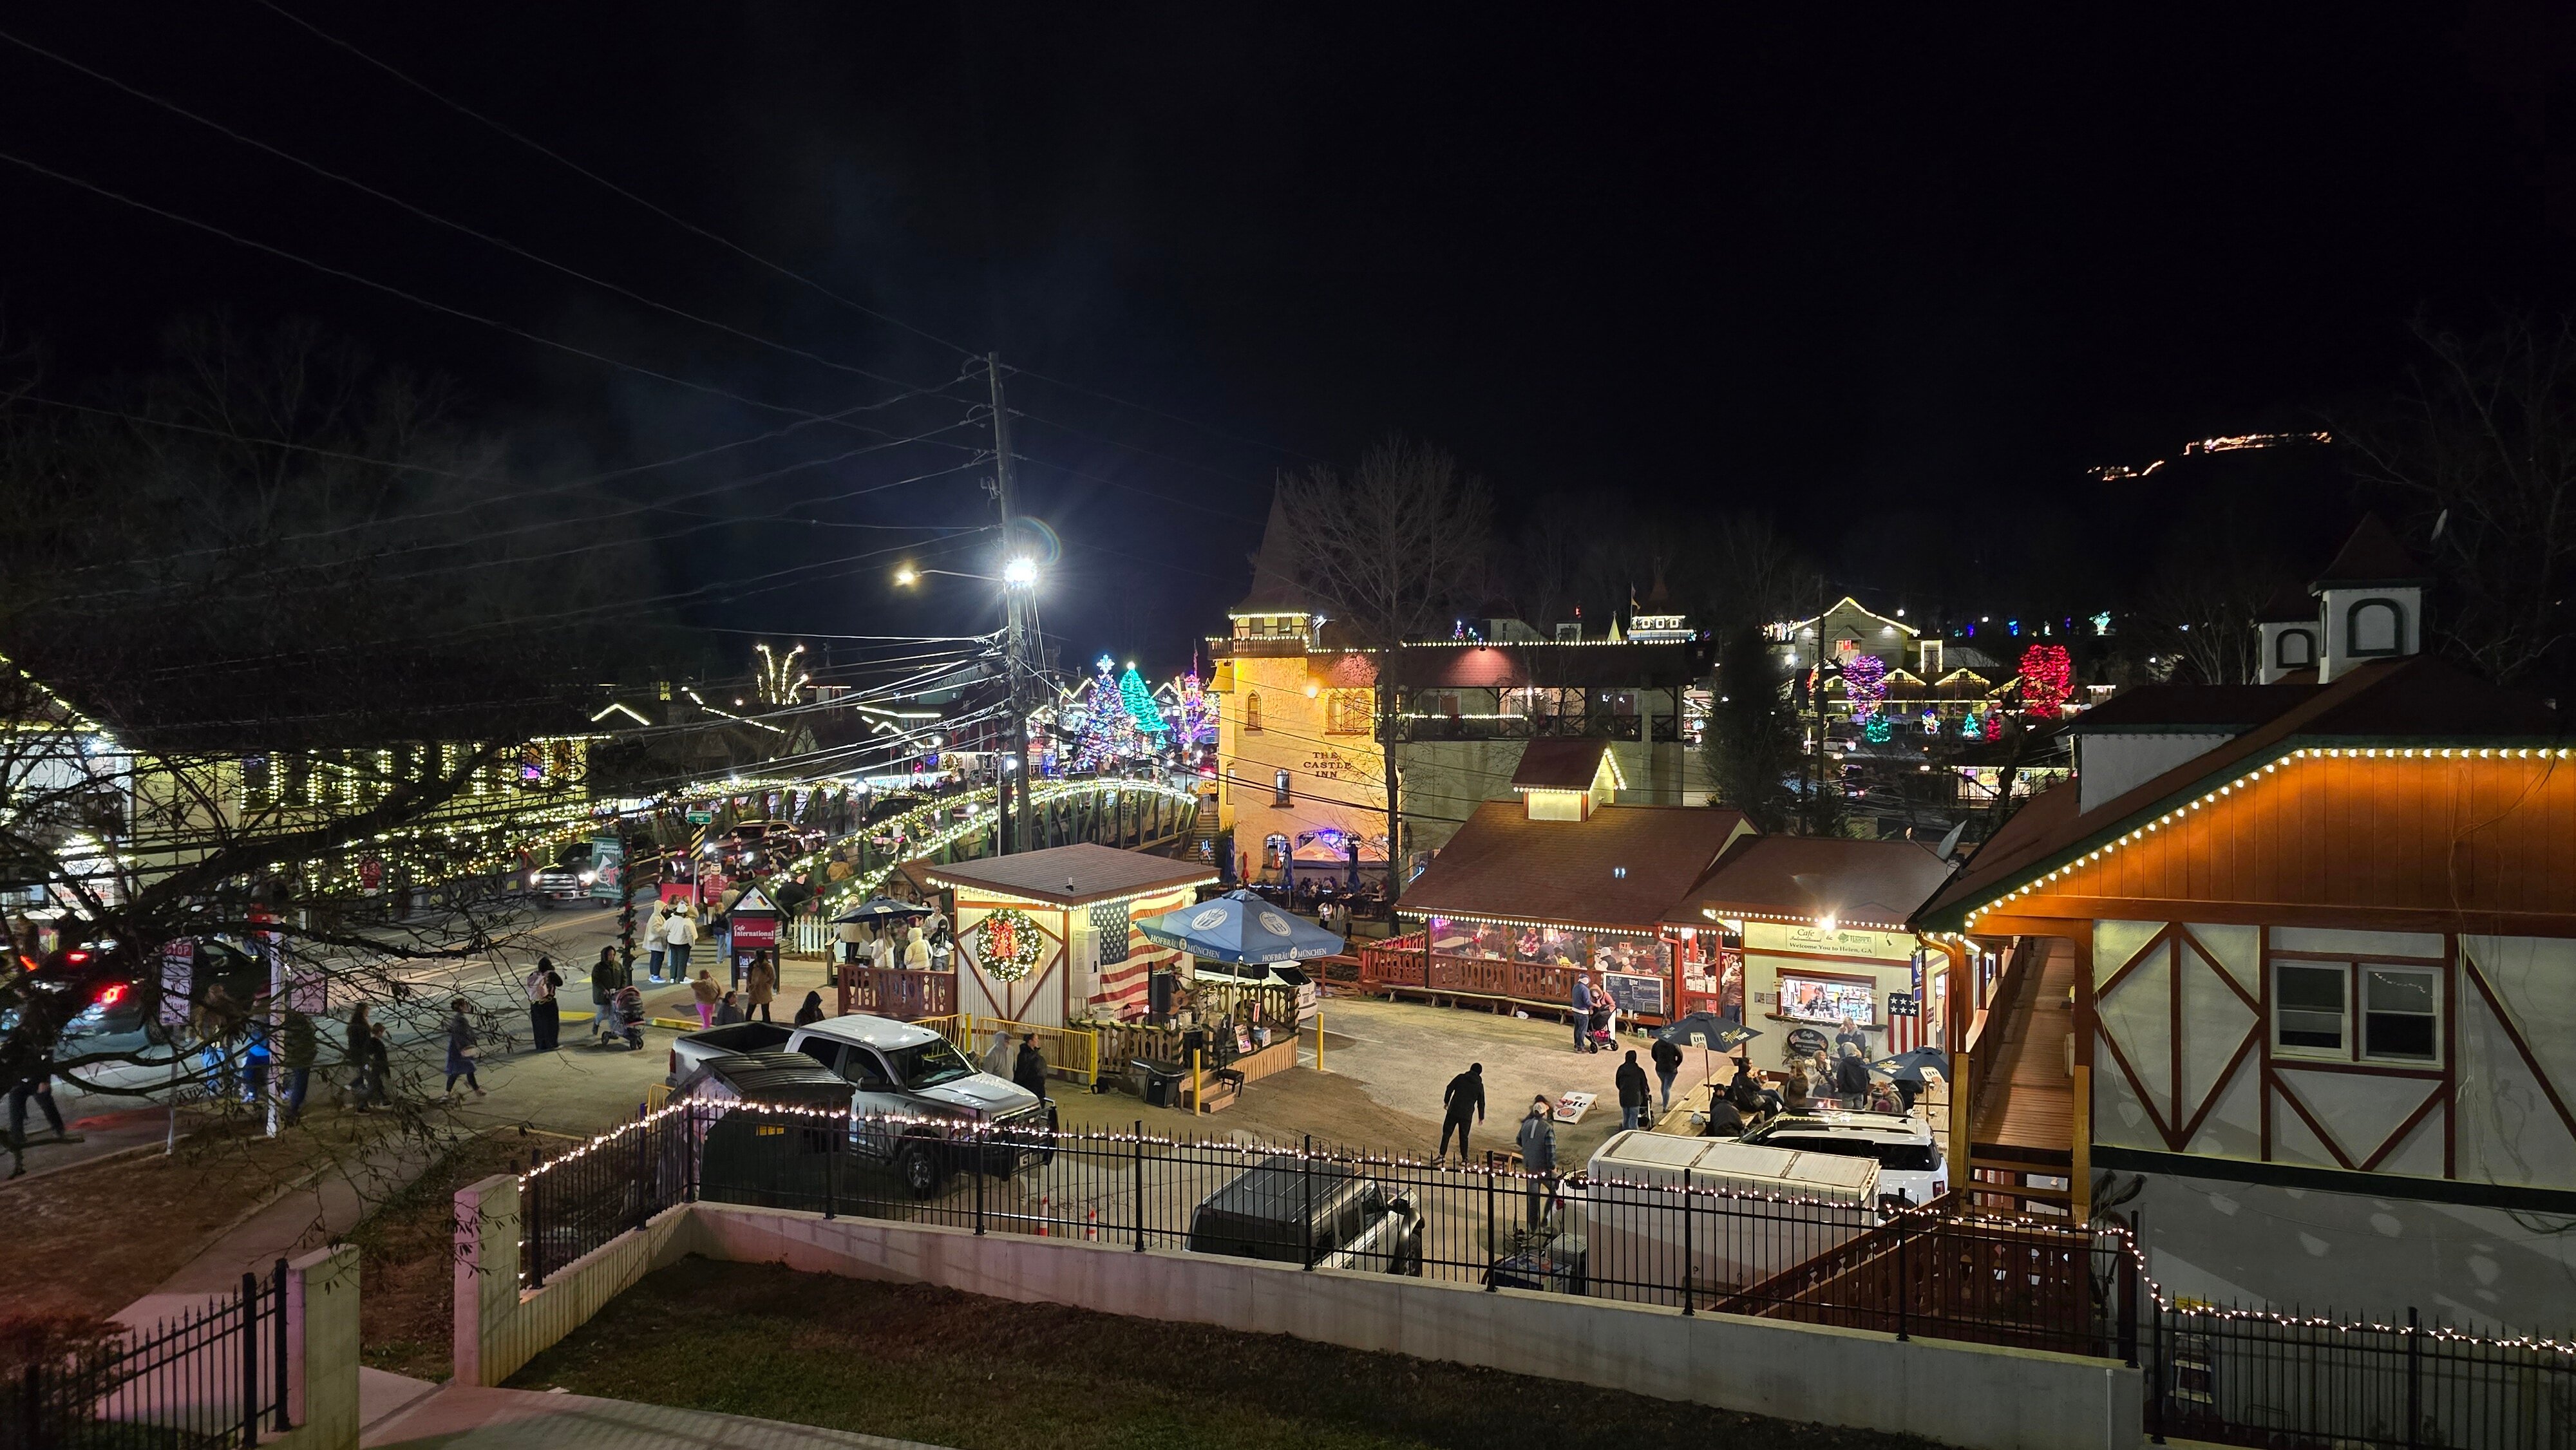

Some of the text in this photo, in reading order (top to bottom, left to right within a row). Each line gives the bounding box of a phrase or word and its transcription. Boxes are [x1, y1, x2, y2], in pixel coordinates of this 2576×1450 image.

[1797, 928, 1815, 938] Cafe
[1150, 934, 1220, 959] HOFBRÄU MÜNCHEN
[739, 956, 749, 966] Das
[1262, 948, 1327, 962] HOFBRÄU MÜNCHEN
